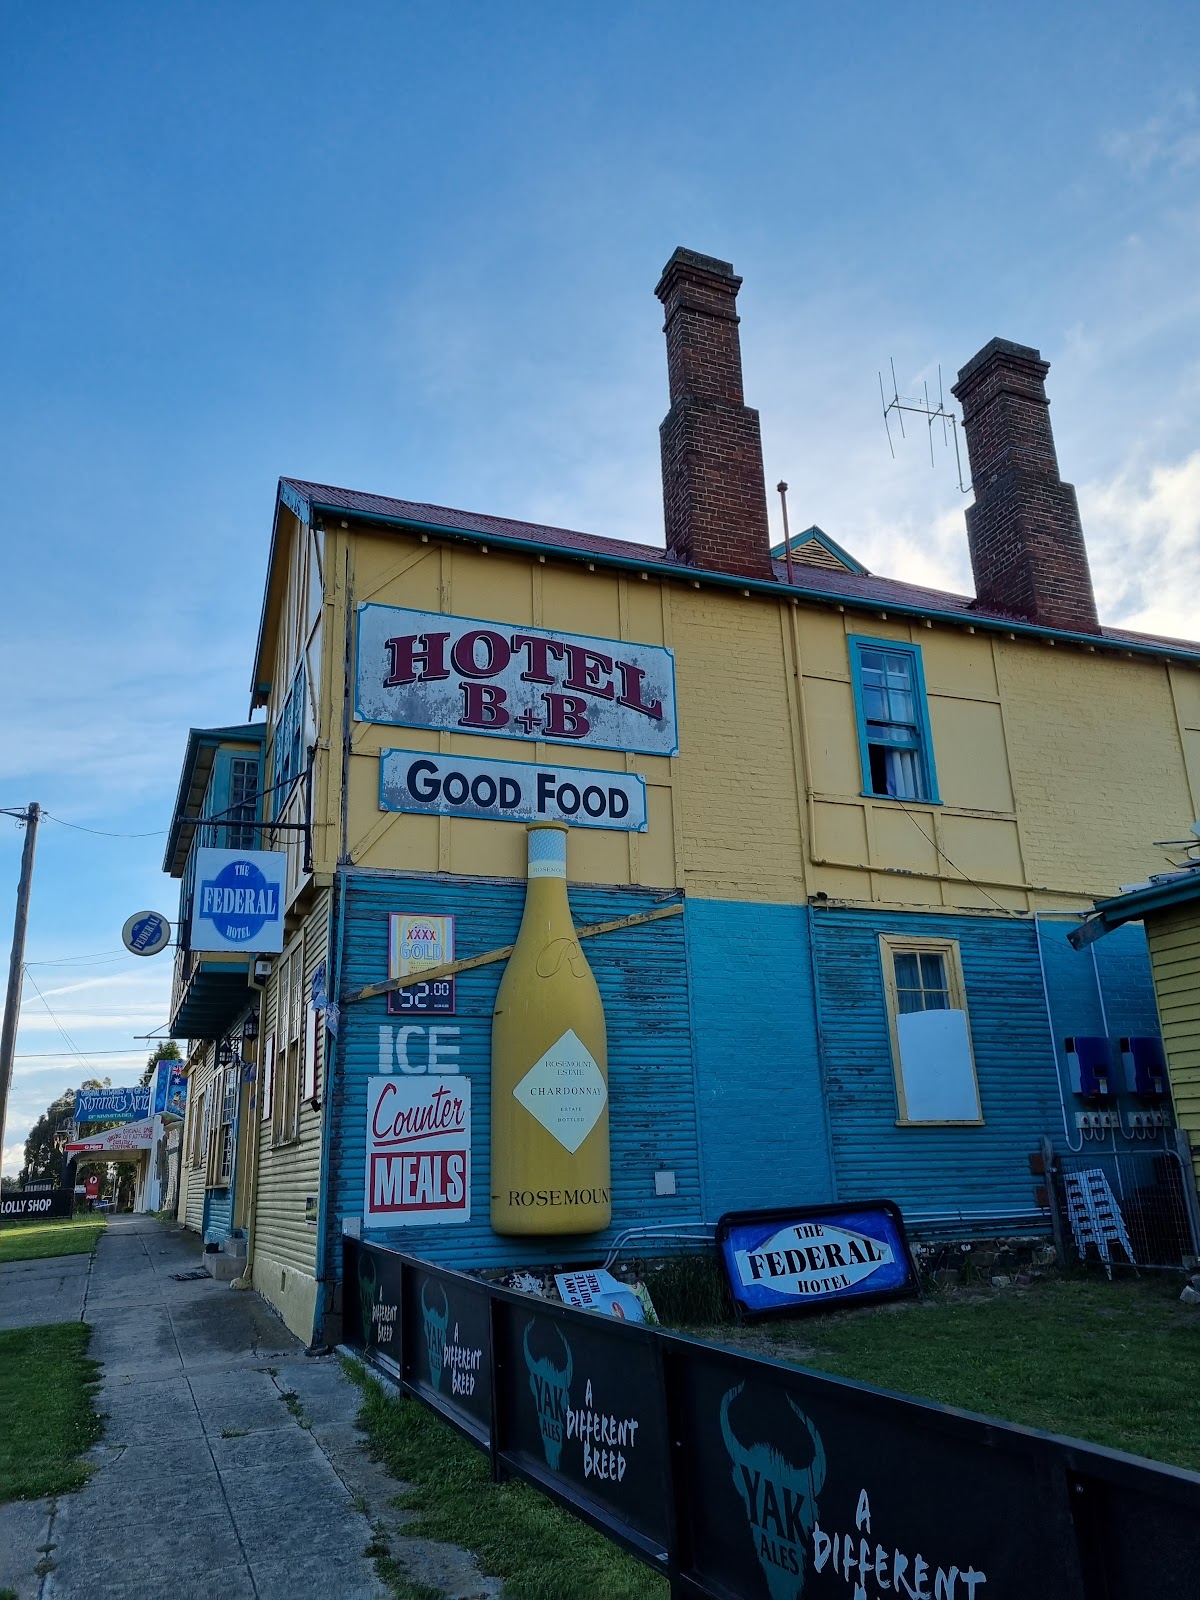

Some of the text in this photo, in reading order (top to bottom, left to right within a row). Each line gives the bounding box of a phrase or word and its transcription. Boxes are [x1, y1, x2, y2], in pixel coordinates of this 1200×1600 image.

[383, 630, 662, 720] HOTEL
[235, 865, 250, 877] THE
[202, 887, 277, 915] FEDERAL
[133, 917, 160, 949] FEDERAL
[227, 925, 251, 939] HOTEL
[407, 929, 436, 941] XXXX
[400, 942, 443, 960] GOLD
[378, 1026, 461, 1075] ICE
[530, 1087, 602, 1096] CHARDONNAY
[372, 1083, 465, 1139] Counter
[374, 1154, 465, 1206] MEALS
[1, 1198, 52, 1213] LOLLY SHOP
[793, 1224, 824, 1240] THE
[747, 1239, 882, 1280] FEDERAL
[563, 1277, 578, 1294] ANY
[575, 1274, 593, 1304] BOTTLE
[586, 1273, 601, 1293] HERE
[798, 1274, 851, 1293] HOTEL
[454, 1322, 459, 1343] A
[444, 1343, 482, 1371] DIFFERENT
[452, 1368, 475, 1396] BREED
[585, 1379, 593, 1407] A
[533, 1373, 566, 1422] YAK
[542, 1423, 562, 1443] ALES
[566, 1405, 639, 1448] DIFFERENT
[583, 1441, 627, 1482] BREED
[739, 1463, 812, 1543] YAK
[855, 1488, 872, 1535] A
[759, 1536, 800, 1576] ALES
[812, 1521, 988, 1600] DIFFERENT
